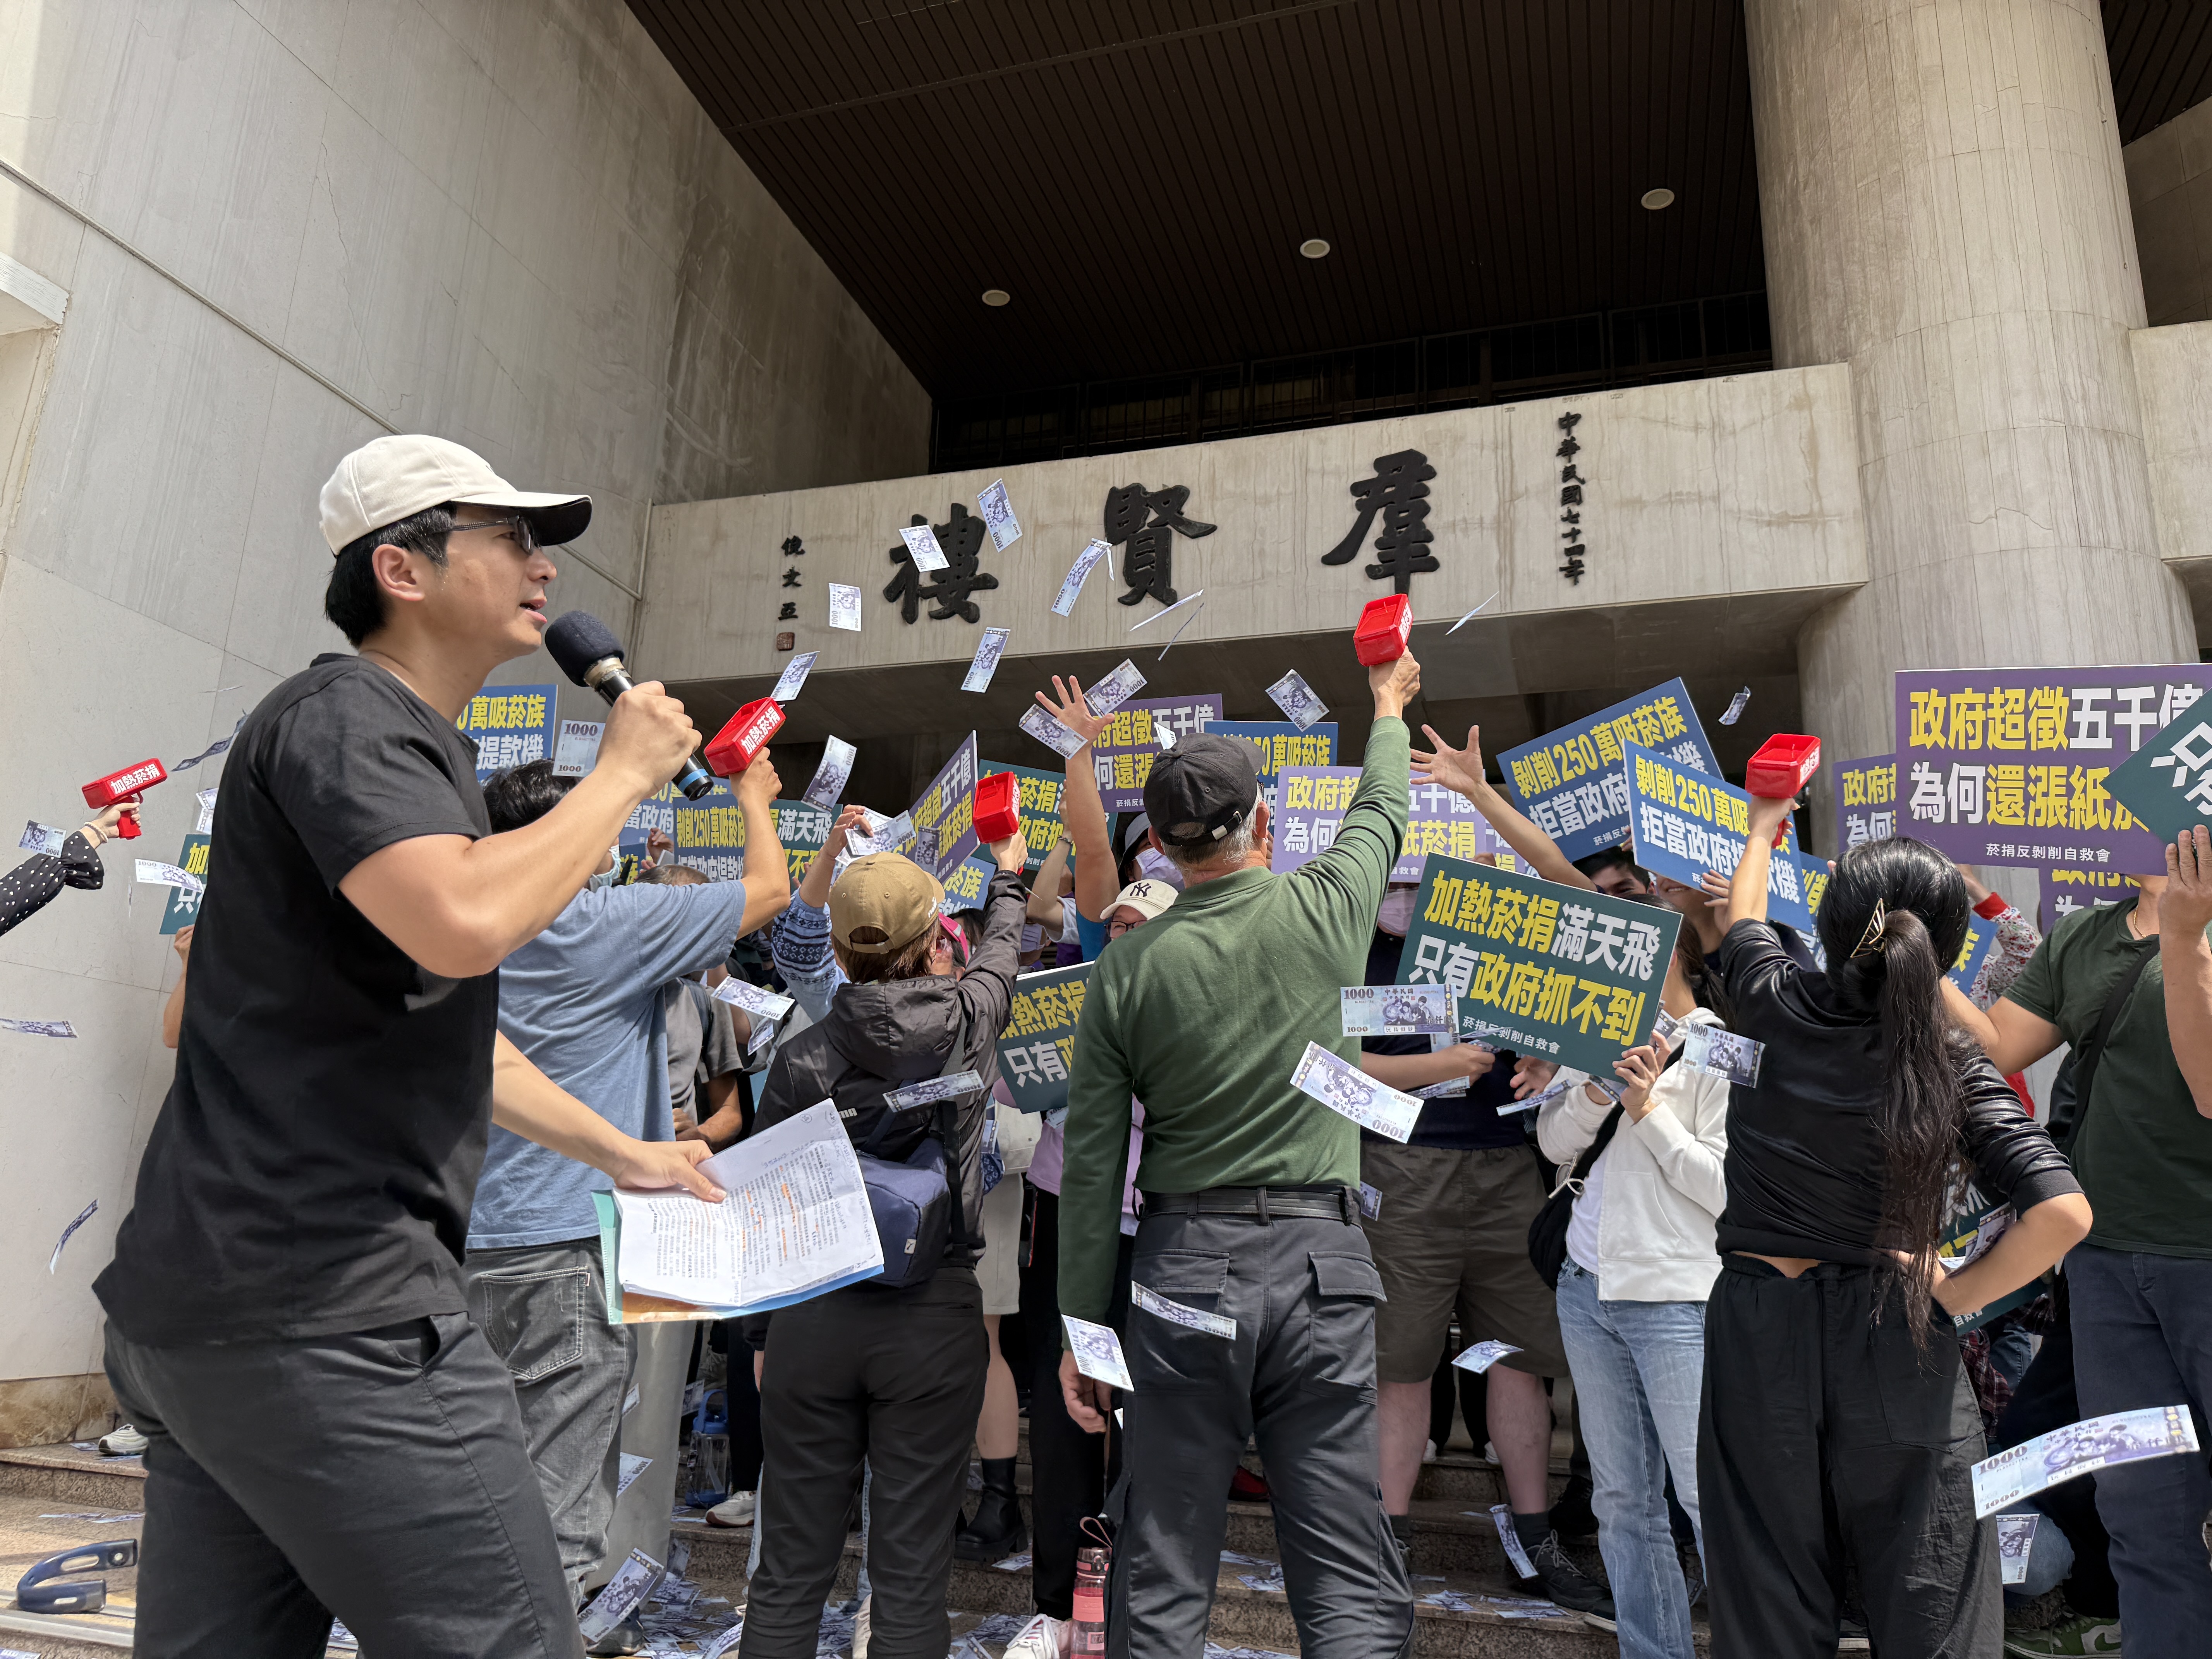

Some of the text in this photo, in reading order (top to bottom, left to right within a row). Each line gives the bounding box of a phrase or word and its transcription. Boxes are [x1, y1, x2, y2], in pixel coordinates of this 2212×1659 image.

[1556, 411, 1586, 586] 中華民國七十四年
[993, 531, 1004, 551] 1000
[1054, 588, 1066, 609] 1000
[963, 671, 975, 689] 1000
[1129, 679, 1145, 693] 1000
[564, 723, 598, 736] 1000
[741, 706, 781, 755] 加熱菸捐
[1293, 716, 1308, 730] 1000
[472, 734, 544, 770] 提款機
[845, 747, 855, 766] 1000
[1056, 745, 1072, 756] 1000
[1511, 696, 1687, 799] 剝削250萬吸菸族
[111, 763, 160, 794] 加熱菸捐
[1094, 751, 1160, 791] 何還漲
[1018, 776, 1063, 814] 菸捐
[1843, 763, 1896, 807] 政府
[939, 790, 973, 859] 紙菸捐
[1846, 810, 1896, 848] 為何
[897, 831, 914, 845] 1000
[45, 847, 60, 856] 1000
[1985, 843, 2111, 863] 菸捐反剝削自救會
[1424, 870, 1661, 981] 加熱菸捐滿天飛
[1344, 988, 1374, 1000] 1000
[1408, 934, 1646, 1045] 只有政府抓不到
[761, 1009, 781, 1018] 1000
[1463, 1015, 1561, 1055] 菸捐反剝削自救會
[1690, 1023, 1708, 1037] 1000
[1394, 1093, 1417, 1108] 1000
[1372, 1119, 1407, 1140] 1000
[1077, 1355, 1092, 1374] 1000
[1978, 1446, 2028, 1476] 1000
[1984, 1489, 2019, 1510] 1000
